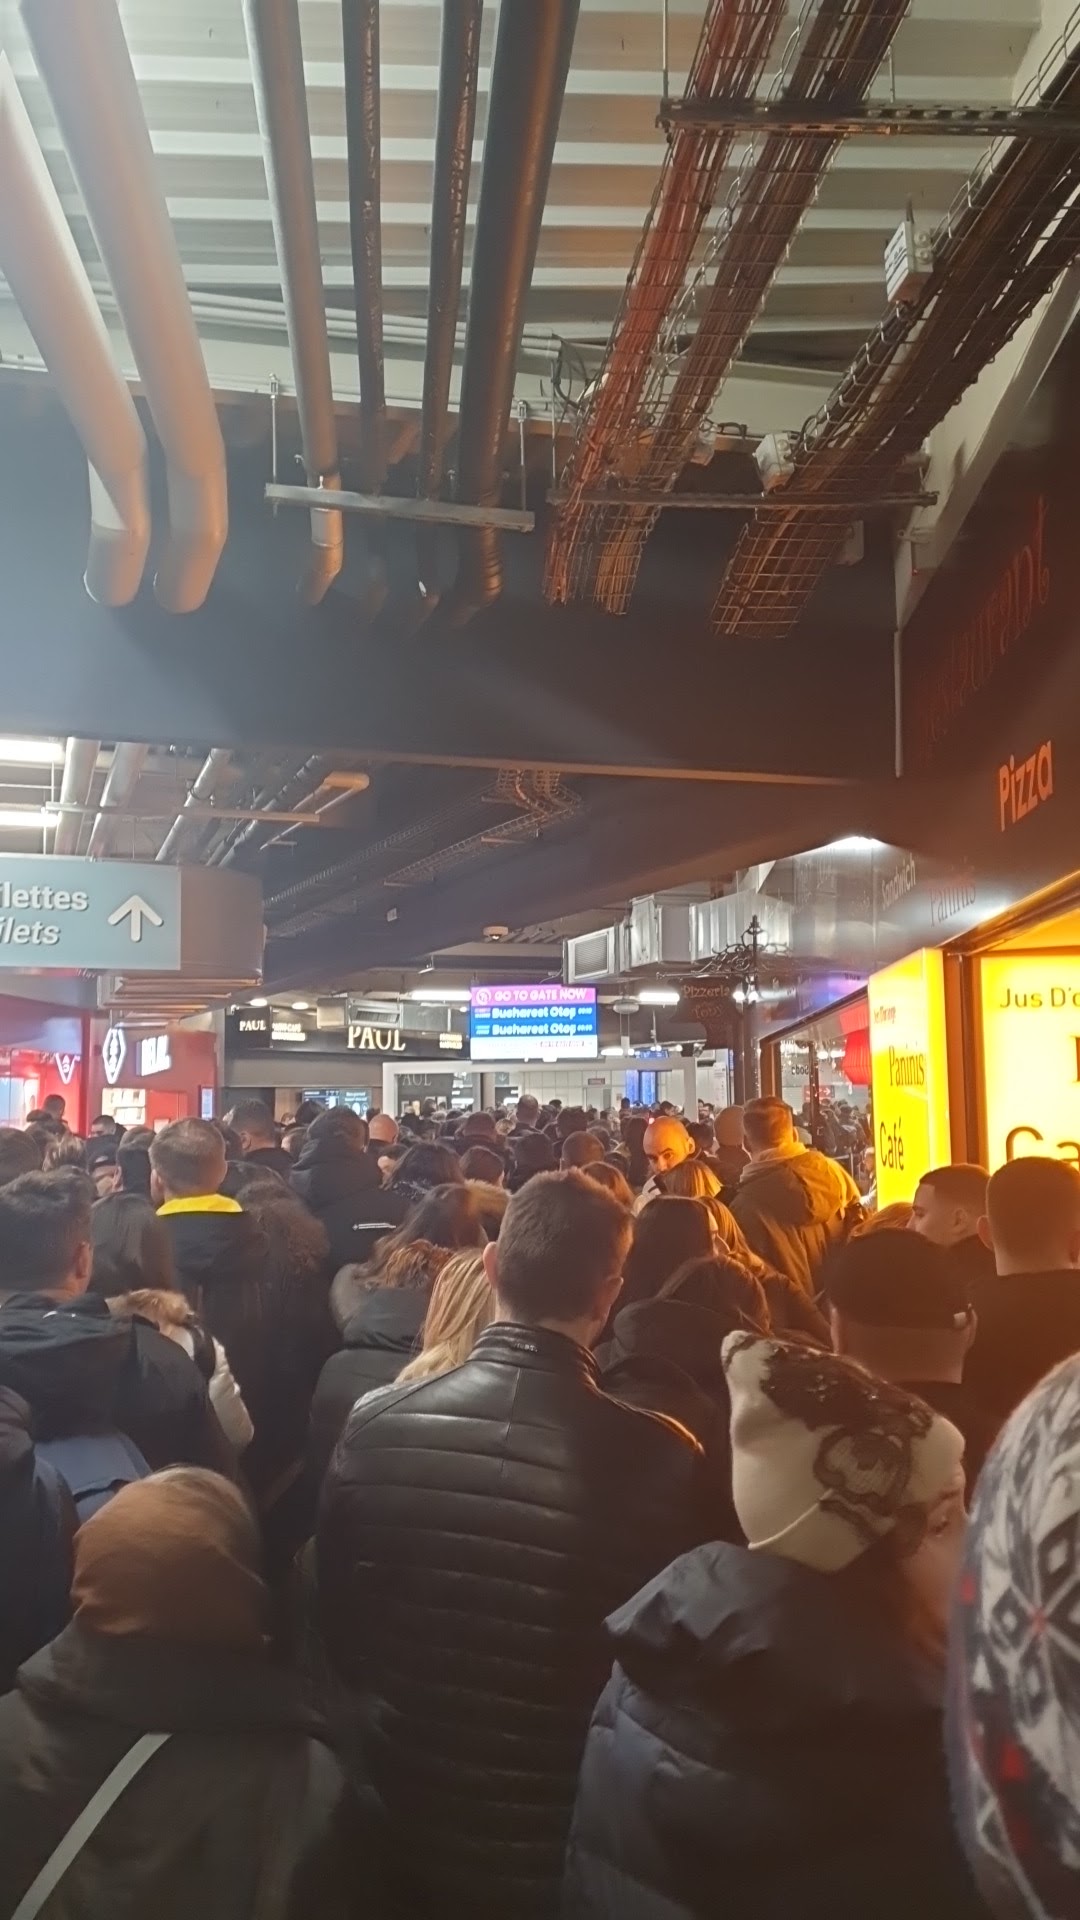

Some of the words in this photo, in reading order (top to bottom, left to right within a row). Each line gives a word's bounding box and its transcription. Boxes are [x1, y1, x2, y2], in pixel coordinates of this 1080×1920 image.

[999, 739, 1054, 833] Pizza
[881, 852, 917, 911] Sandwich
[494, 990, 512, 1002] GO
[513, 990, 529, 1002] TO
[530, 989, 558, 1001] GATE
[560, 988, 587, 1000] NOW
[1000, 987, 1043, 1009] Jus
[492, 1007, 548, 1018] Bucharest
[239, 1020, 267, 1032] PAUL
[492, 1024, 549, 1036] Bucharest
[347, 1026, 406, 1051] PAUL
[888, 1042, 925, 1087] Paninis
[879, 1116, 905, 1172] Café
